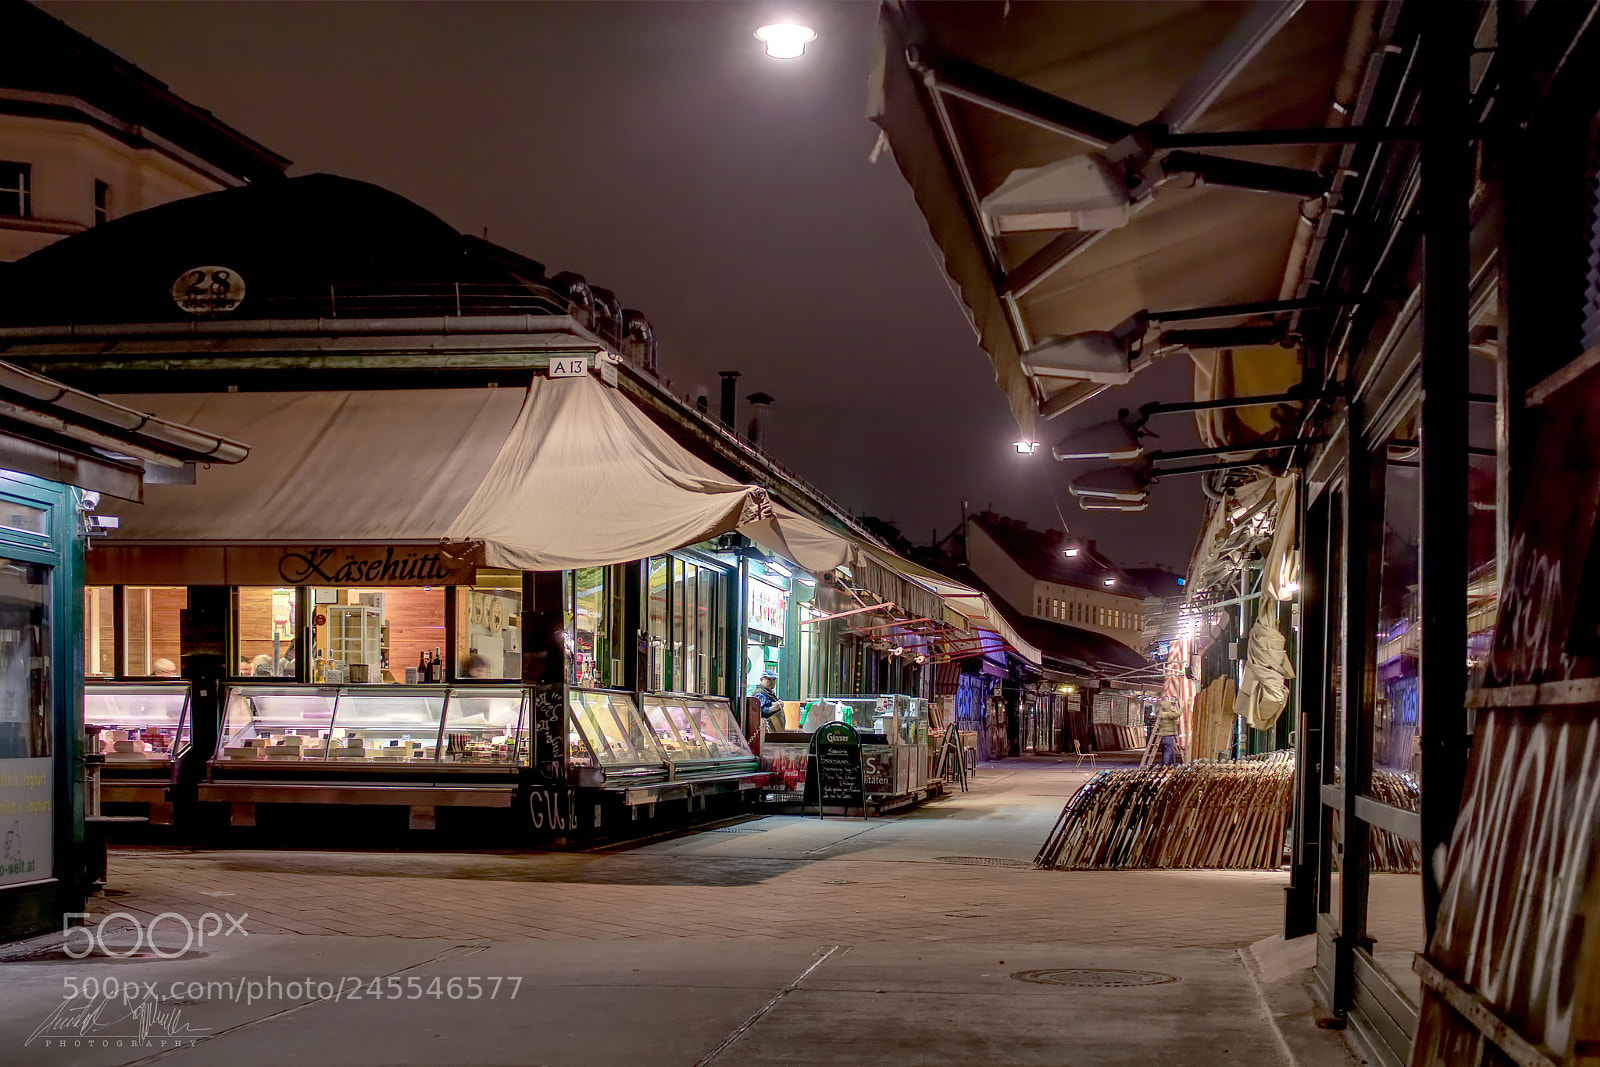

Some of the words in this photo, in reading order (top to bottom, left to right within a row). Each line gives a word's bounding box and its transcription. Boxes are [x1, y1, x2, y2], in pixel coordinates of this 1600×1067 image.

[184, 271, 231, 295] 28
[553, 361, 566, 374] A
[570, 360, 583, 374] 13
